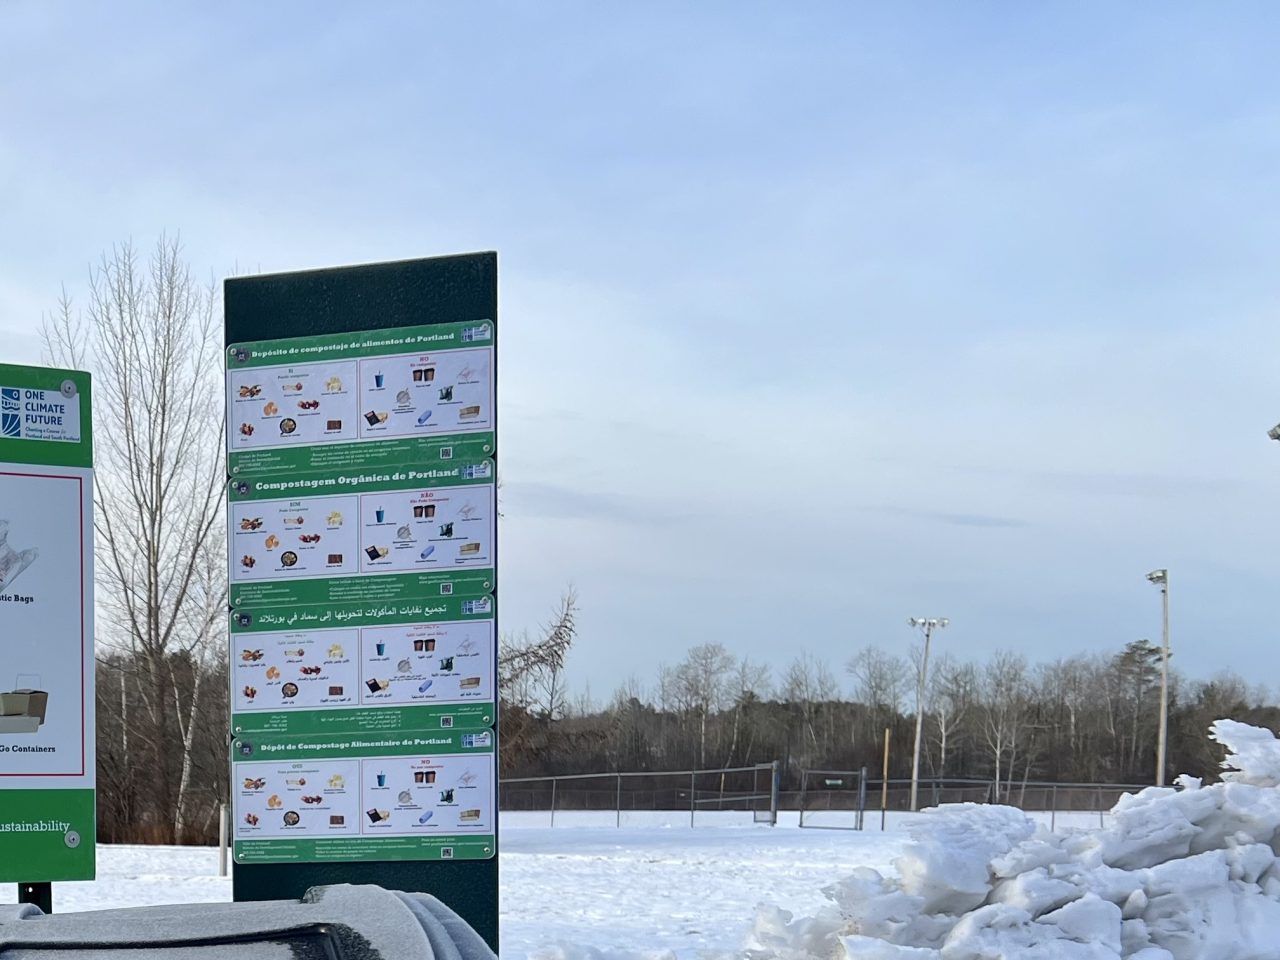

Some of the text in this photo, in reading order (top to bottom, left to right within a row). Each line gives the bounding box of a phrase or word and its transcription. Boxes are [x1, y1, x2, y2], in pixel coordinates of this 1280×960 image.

[300, 342, 348, 353] compostaje
[362, 338, 404, 348] alimentos
[417, 333, 455, 342] Portland
[25, 390, 45, 401] ONE
[25, 402, 65, 414] CLIMATE
[25, 414, 63, 426] FUTURE
[256, 468, 460, 490] Compostagem Orgânica de Portland
[14, 595, 34, 604] Bags
[287, 612, 298, 625] في
[12, 744, 56, 753] Containers
[298, 742, 350, 750] Compostage
[351, 740, 400, 748] Alimentaire
